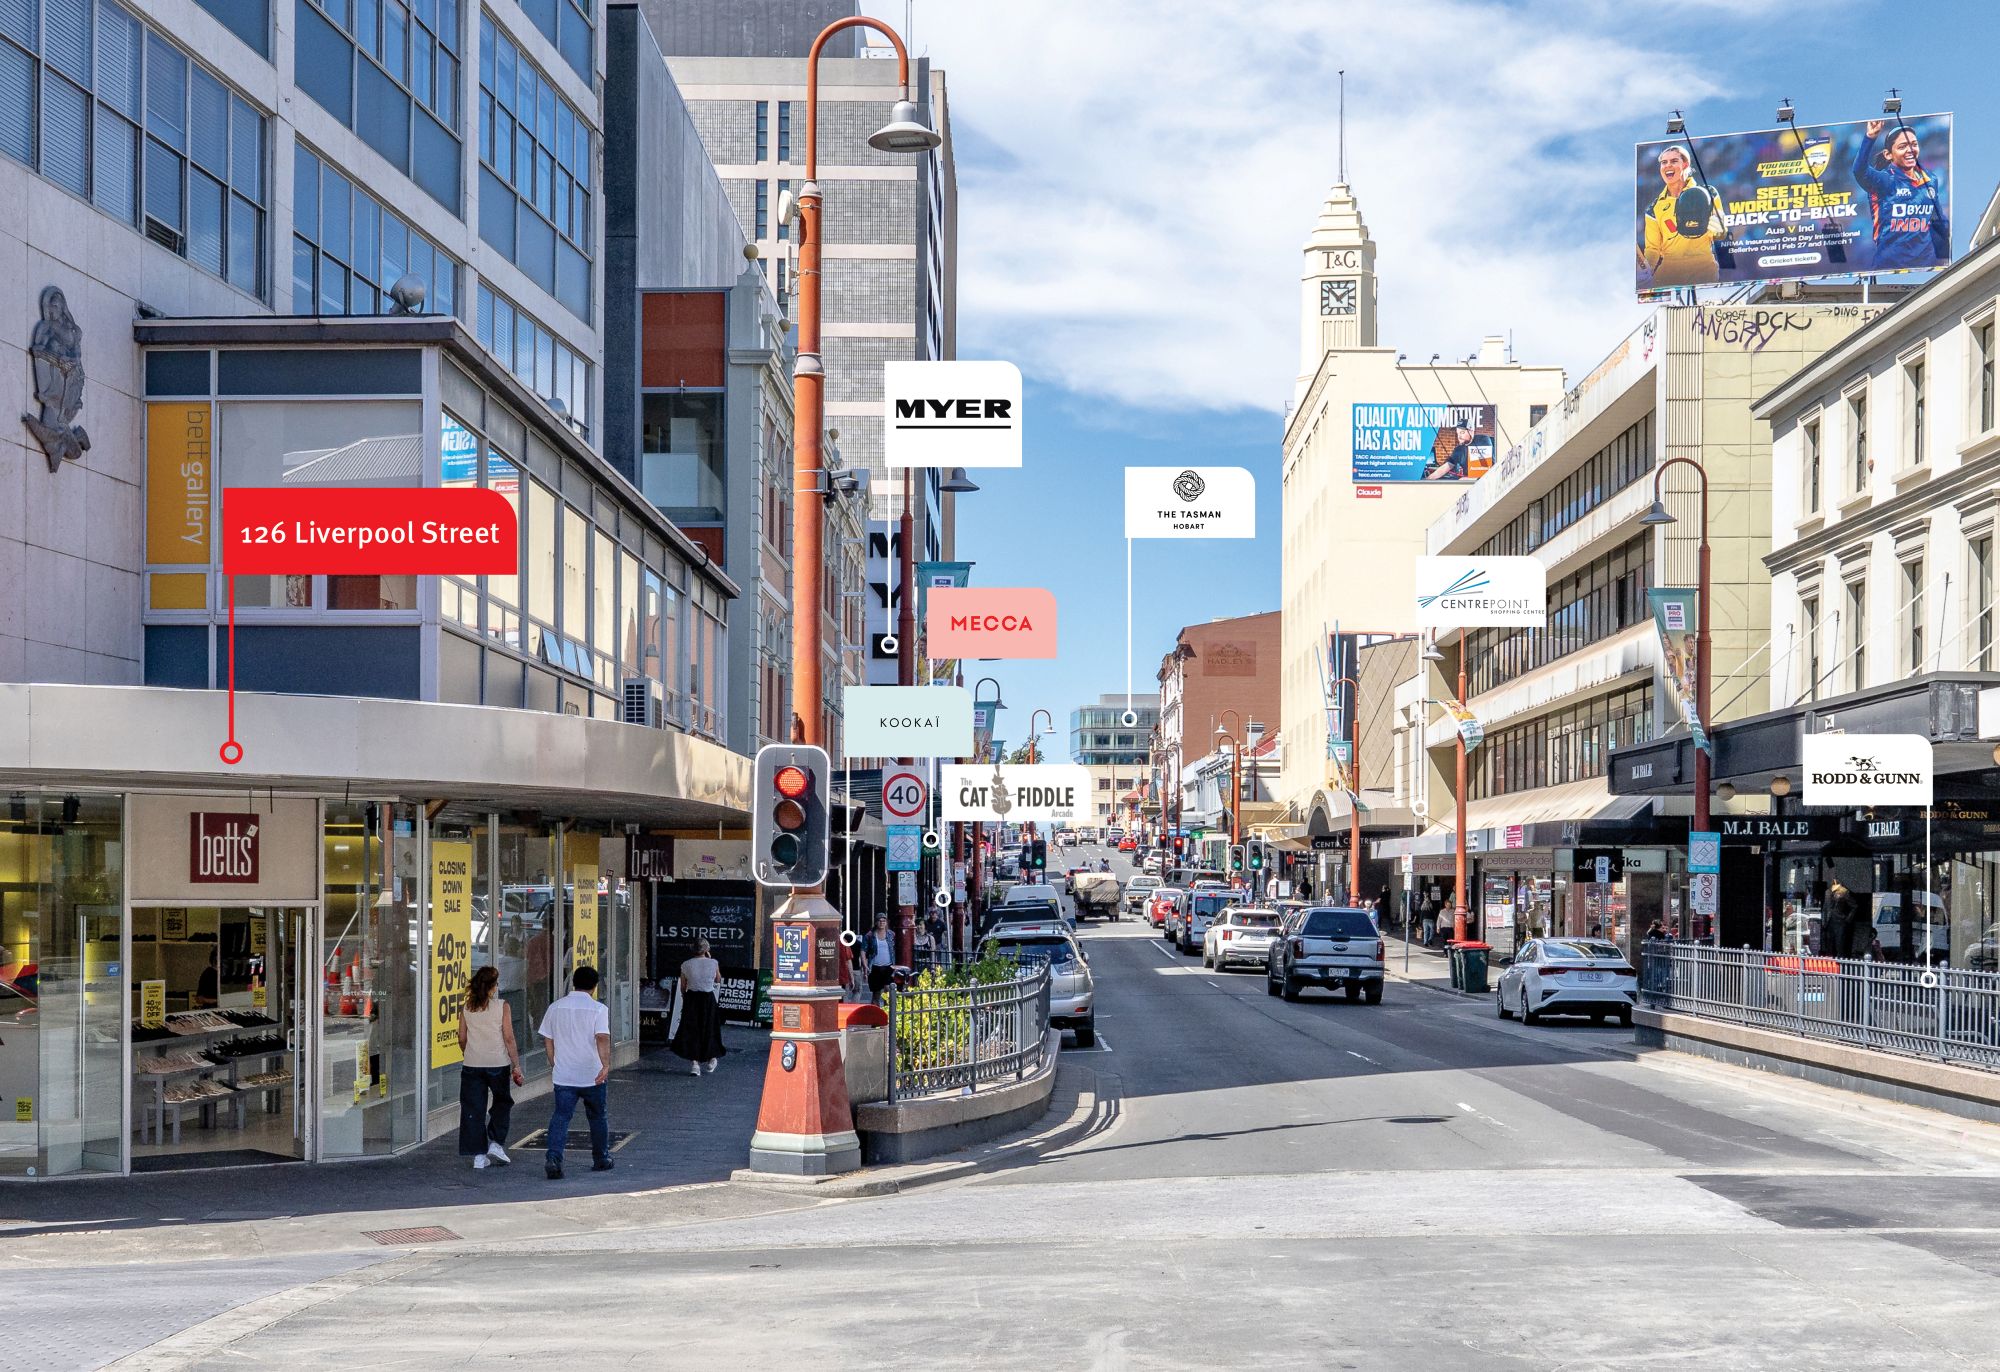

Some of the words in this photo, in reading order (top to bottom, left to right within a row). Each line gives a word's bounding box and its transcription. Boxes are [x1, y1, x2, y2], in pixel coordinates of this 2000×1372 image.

[1757, 186, 1788, 200] SEE
[1791, 183, 1823, 197] THE
[1729, 197, 1804, 214] WORLD'S
[1807, 192, 1851, 207] BEST
[1723, 204, 1857, 227] BACK-TO-BACK
[1765, 227, 1785, 235] Aus
[1798, 224, 1814, 232] Ind
[1745, 238, 1780, 246] Insurance
[1798, 235, 1813, 243] Day
[1814, 230, 1860, 240] International
[1728, 246, 1759, 254] Bellerive
[1782, 242, 1796, 250] Feb
[1808, 240, 1822, 248] and
[1824, 239, 1847, 247] March
[1769, 257, 1793, 265] Cricket
[1794, 255, 1817, 263] tickets
[1834, 306, 1858, 317] DING
[1692, 308, 1780, 354] ANGRY
[1355, 406, 1404, 429] QUALITY
[1406, 406, 1484, 428] AUTOMOTIVE
[1355, 429, 1380, 450] HAS
[1382, 430, 1391, 450] A
[1393, 429, 1421, 451] SIGN
[1357, 488, 1382, 496] Claude
[890, 785, 919, 805] 40
[1959, 811, 1989, 819] GUNN
[1723, 821, 1753, 835] M.J.
[1759, 821, 1809, 836] BALE
[1880, 821, 1900, 837] BALE
[200, 812, 252, 876] betts
[439, 861, 466, 875] CLOSING
[442, 881, 462, 893] DOWN
[578, 879, 594, 890] CLOSING
[444, 899, 461, 913] SALE
[580, 894, 593, 904] DOWN
[580, 908, 591, 919] SALE
[681, 926, 737, 939] STREET
[438, 933, 454, 961] 40
[455, 941, 466, 959] TO
[577, 934, 587, 957] 40
[588, 941, 594, 956] TO
[819, 948, 835, 956] STREET
[438, 960, 465, 992] 70%
[720, 977, 755, 990] LUSH
[720, 988, 754, 999] FRESH
[439, 993, 465, 1024] OFF
